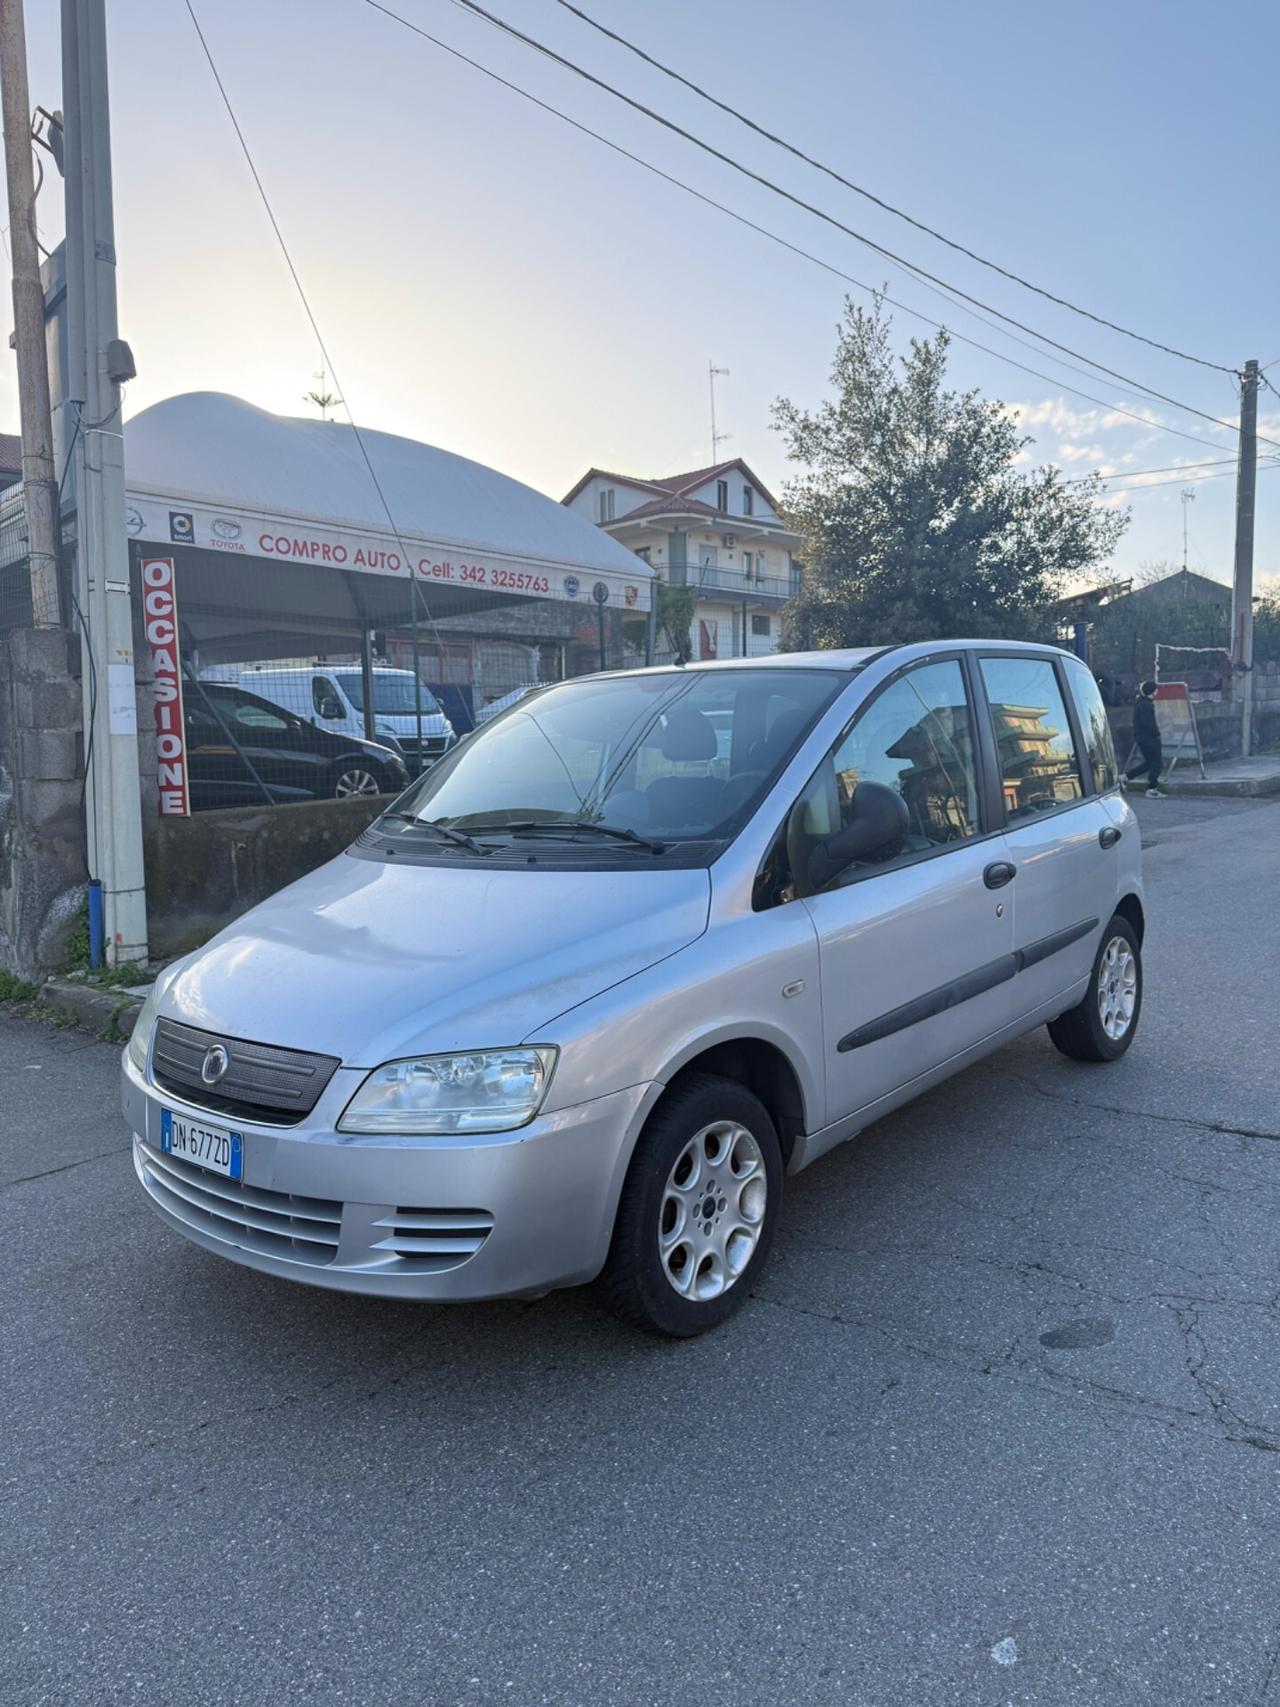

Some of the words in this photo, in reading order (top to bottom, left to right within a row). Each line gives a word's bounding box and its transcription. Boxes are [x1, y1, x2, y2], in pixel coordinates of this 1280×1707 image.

[210, 538, 246, 552] TOYOTA
[258, 533, 348, 564] COMPRO
[354, 549, 401, 572] AUTO
[418, 558, 455, 580] Cell:
[459, 564, 486, 584] 342
[490, 569, 550, 593] 3255763
[143, 561, 185, 815] OCCASIONE
[171, 1120, 187, 1152] DN
[190, 1127, 230, 1167] 677ZD
